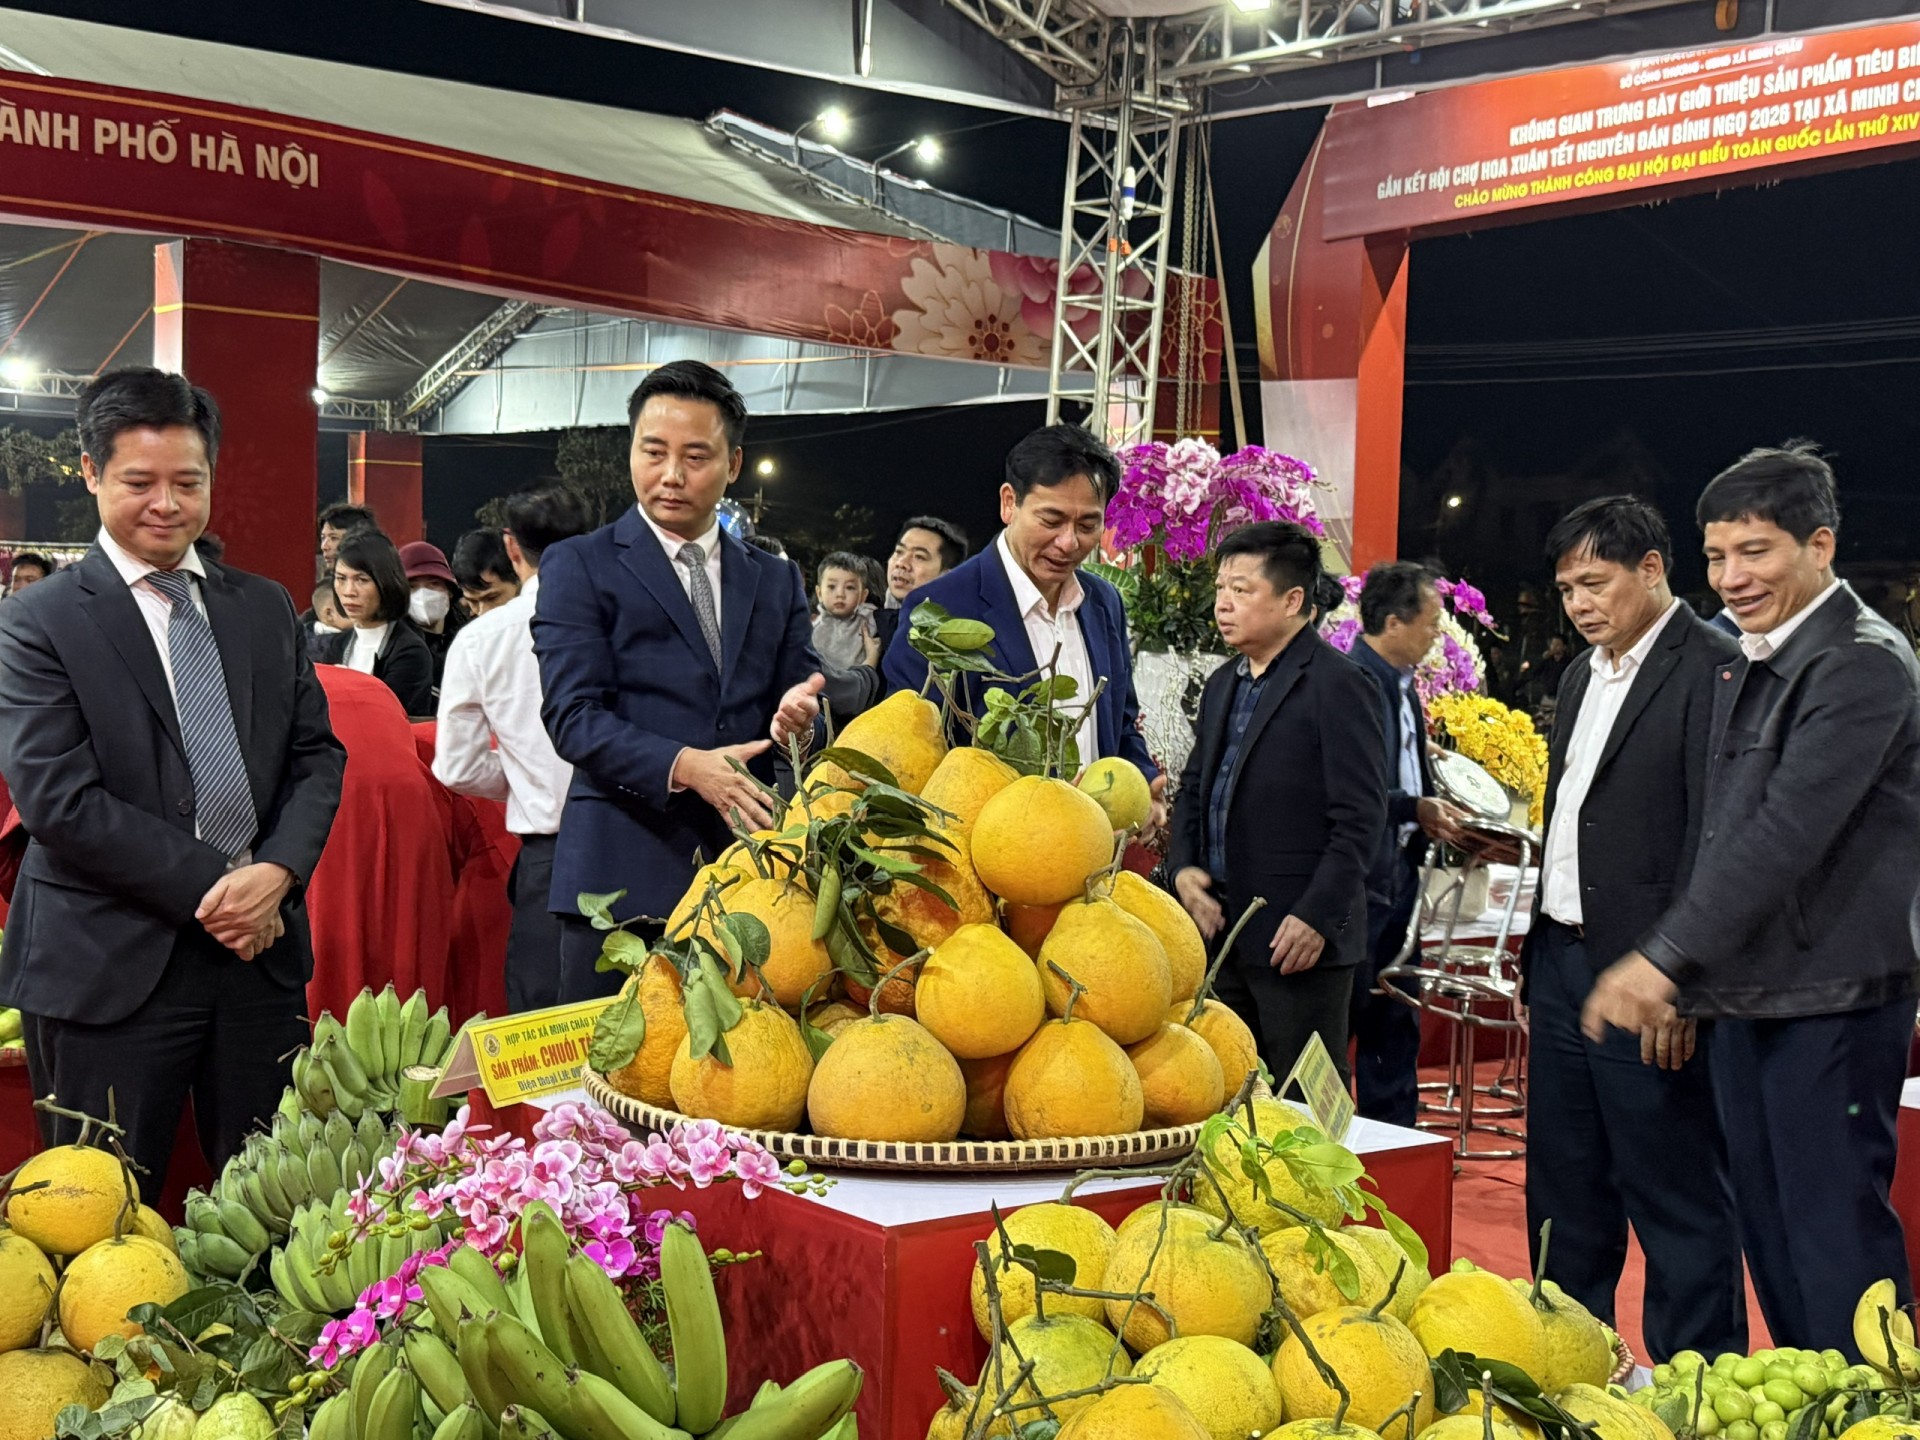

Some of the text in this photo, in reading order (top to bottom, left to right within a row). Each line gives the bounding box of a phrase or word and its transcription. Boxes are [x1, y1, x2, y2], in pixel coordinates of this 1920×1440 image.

[1404, 170, 1426, 195] KẾT
[1428, 166, 1450, 192] HỘI
[1453, 160, 1480, 187] CHỢ
[1481, 158, 1508, 180] HOA
[1510, 150, 1548, 176] XUÂN
[1550, 141, 1575, 167] TẾT
[1576, 132, 1635, 164] NGUYÊN
[1637, 122, 1671, 152] ĐÁN
[1672, 116, 1711, 146] BÍNH
[1713, 110, 1747, 140] NGỌ
[1749, 103, 1790, 131] 2026
[1793, 98, 1821, 126] TẠI
[1823, 88, 1848, 117] XÃ
[1850, 81, 1899, 112] MINH
[1509, 119, 1556, 146] KHÔNG
[1558, 109, 1593, 140] GIAN
[1596, 102, 1644, 130] TRƯNG
[1647, 92, 1678, 119] BÀY
[1679, 83, 1712, 112] GIỚI
[1715, 74, 1760, 105] THIỆU
[1763, 65, 1799, 96] SẢN
[1801, 53, 1851, 89] PHẨM
[1855, 47, 1894, 78] TIÊU
[94, 118, 180, 164] PHỐ
[191, 131, 244, 175] HÀ
[255, 142, 319, 189] NỘI
[1454, 188, 1490, 209] CHÀO
[1491, 181, 1528, 203] MỪNG
[1530, 173, 1572, 197] THÀNH
[1574, 168, 1615, 189] CÔNG
[1617, 160, 1641, 182] ĐẠI
[1643, 157, 1669, 178] HỘI
[1671, 152, 1696, 173] ĐẠI
[1699, 140, 1730, 166] BIỂU
[1732, 136, 1773, 160] TOÀN
[1774, 124, 1821, 153] QUỐC
[1858, 114, 1889, 138] THỨ
[1891, 112, 1920, 133] XIV
[491, 1058, 512, 1080] SẢN
[539, 1034, 579, 1068] CHUỐI
[505, 1031, 520, 1046] HỢP
[522, 1027, 537, 1041] TÁC
[550, 1022, 570, 1035] MINH
